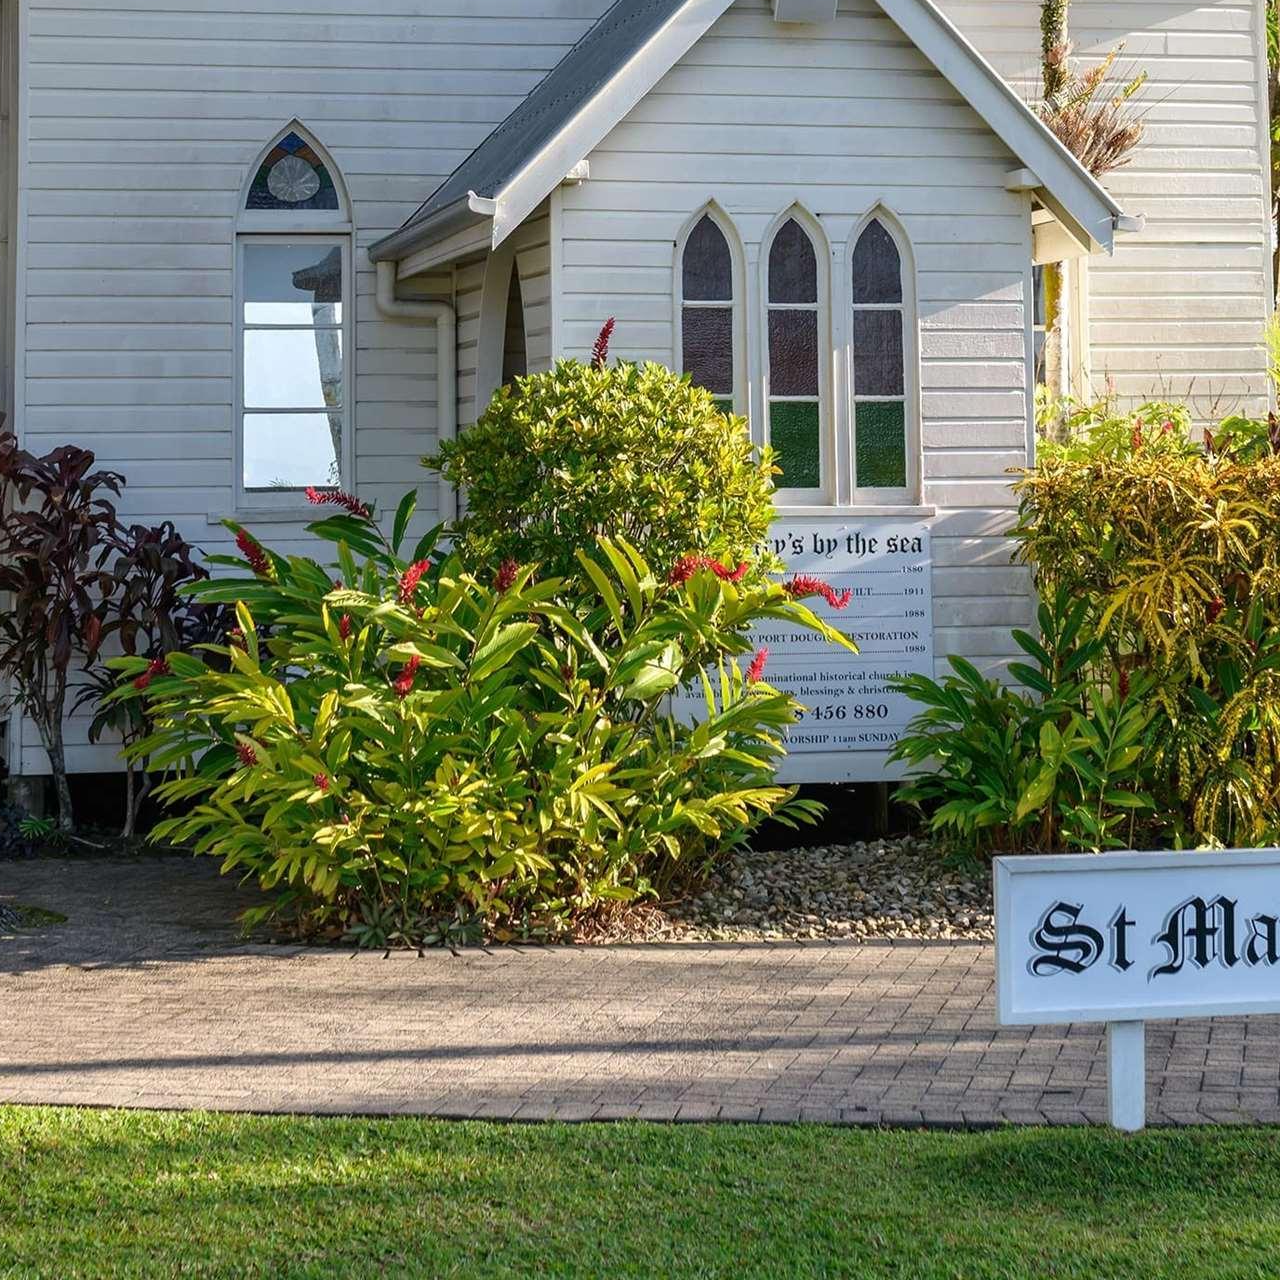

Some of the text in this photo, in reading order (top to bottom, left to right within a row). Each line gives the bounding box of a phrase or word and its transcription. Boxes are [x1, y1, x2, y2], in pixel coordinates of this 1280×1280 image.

[813, 531, 838, 559] by
[846, 531, 878, 559] the
[886, 533, 922, 555] sea
[902, 565, 923, 573] 1880
[904, 587, 924, 596] 1911
[904, 609, 925, 618] 1988
[759, 633, 788, 643] PORT
[790, 631, 826, 642] DOUG
[904, 645, 926, 654] 1989
[820, 671, 866, 682] historical
[868, 670, 901, 681] church
[800, 685, 845, 697] blessings
[847, 684, 856, 695] &
[811, 704, 846, 720] 456
[853, 703, 889, 719] 880
[781, 734, 829, 745] WORSHIP
[833, 734, 857, 743] 11am
[858, 732, 900, 743] SUNDAY
[1026, 899, 1136, 977] St
